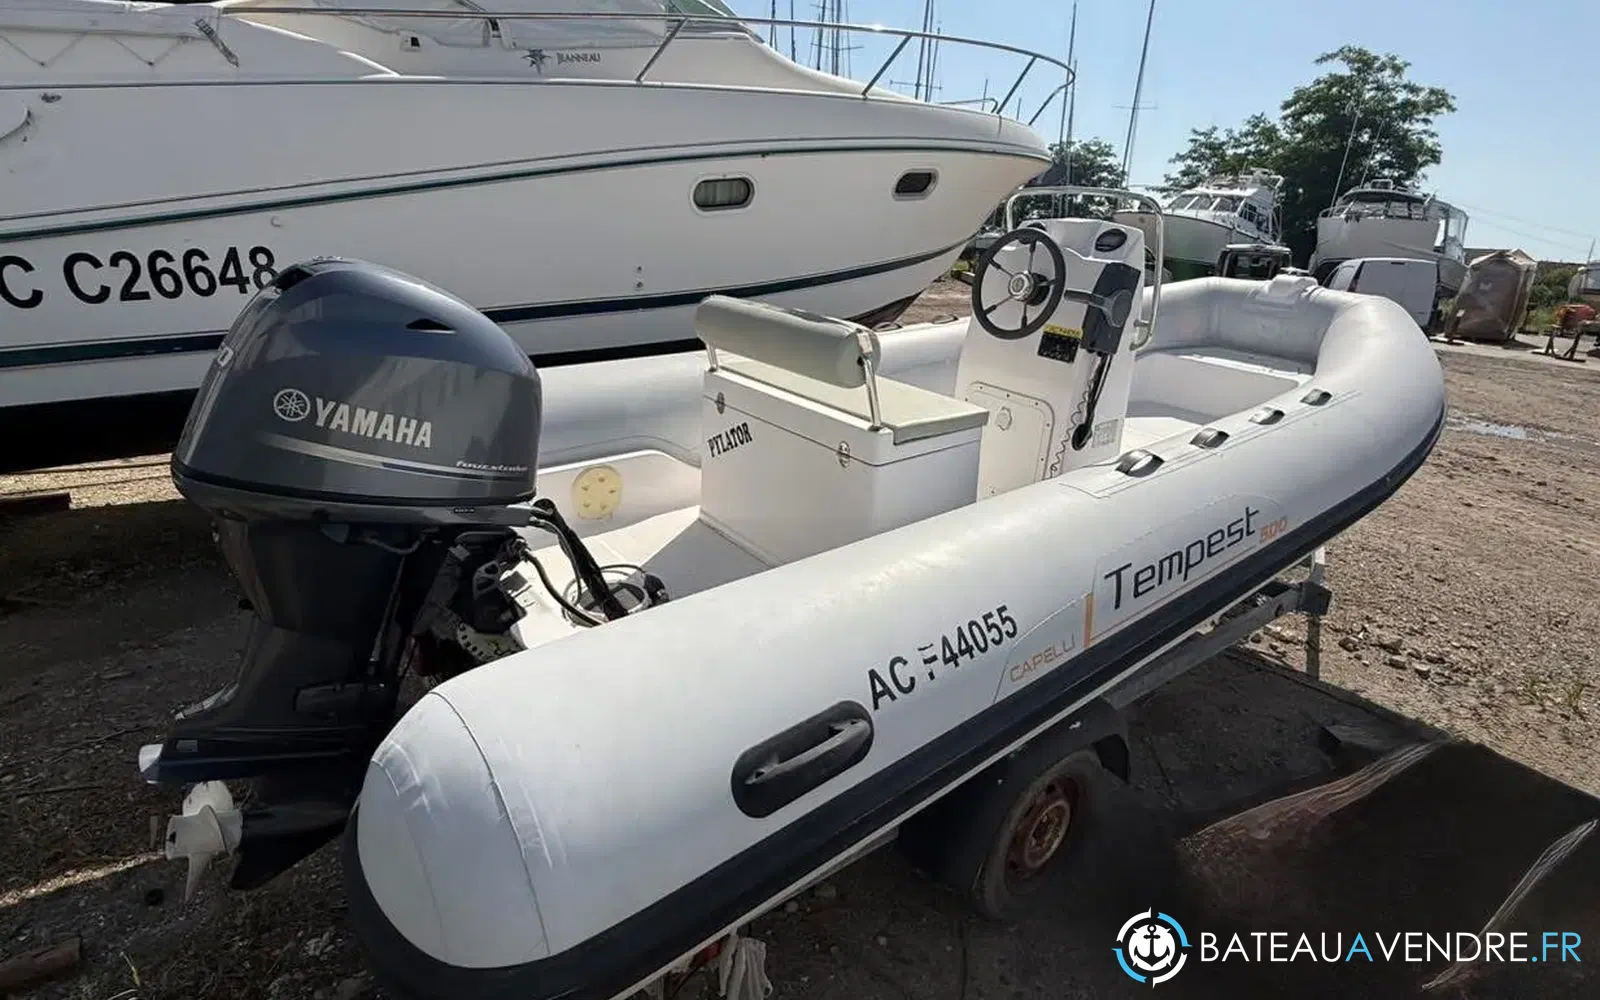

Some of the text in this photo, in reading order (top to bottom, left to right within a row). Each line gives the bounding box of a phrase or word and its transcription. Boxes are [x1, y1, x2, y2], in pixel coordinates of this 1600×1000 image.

[556, 52, 601, 65] JEANNEAU
[62, 246, 277, 304] C26648
[315, 397, 433, 449] YAMAHA
[707, 422, 752, 457] PYLATOR
[1104, 506, 1288, 610] Tempest 500
[868, 655, 916, 710] AC
[1009, 633, 1076, 682] CAPELLI
